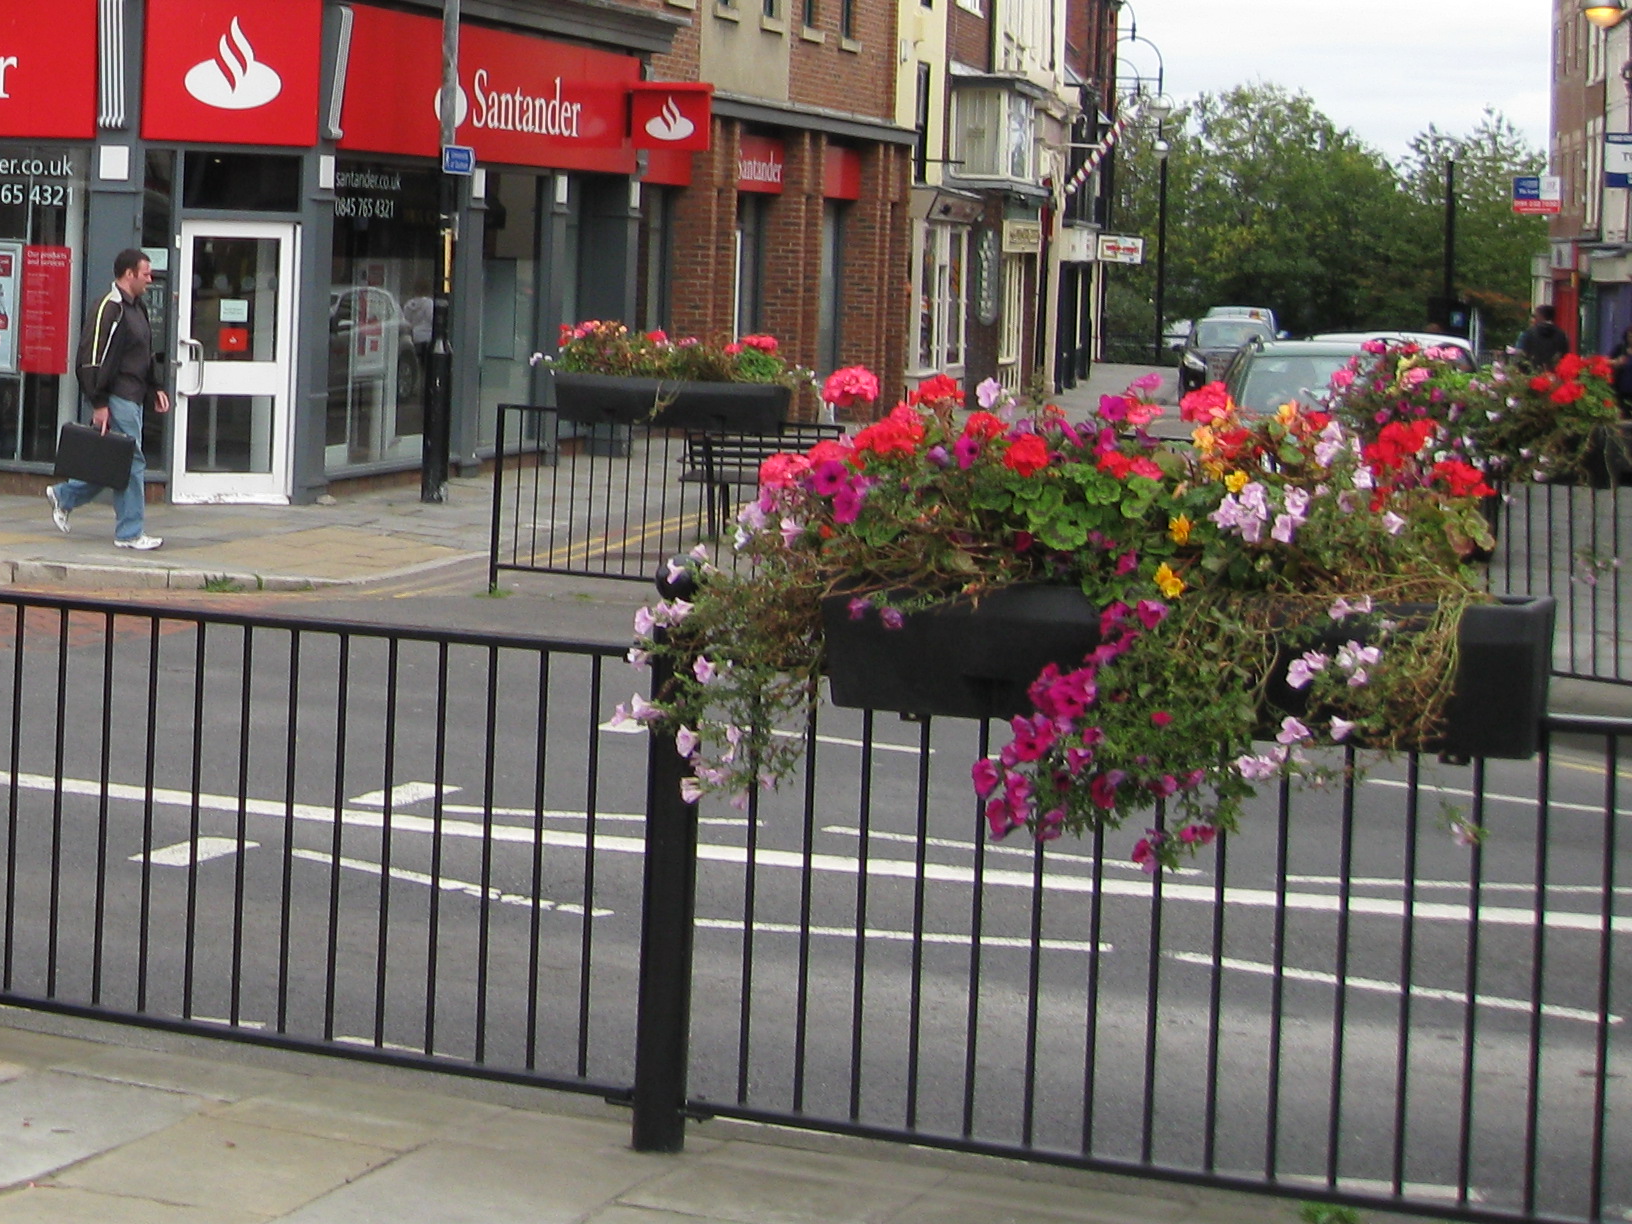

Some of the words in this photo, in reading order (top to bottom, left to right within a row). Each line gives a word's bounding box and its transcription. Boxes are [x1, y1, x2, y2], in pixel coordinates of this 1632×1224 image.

[472, 68, 581, 137] Santander
[335, 168, 402, 191] santander.co.uk
[29, 185, 74, 206] 4321
[334, 197, 356, 218] 0845
[358, 198, 374, 218] 765
[375, 199, 395, 219] 4321
